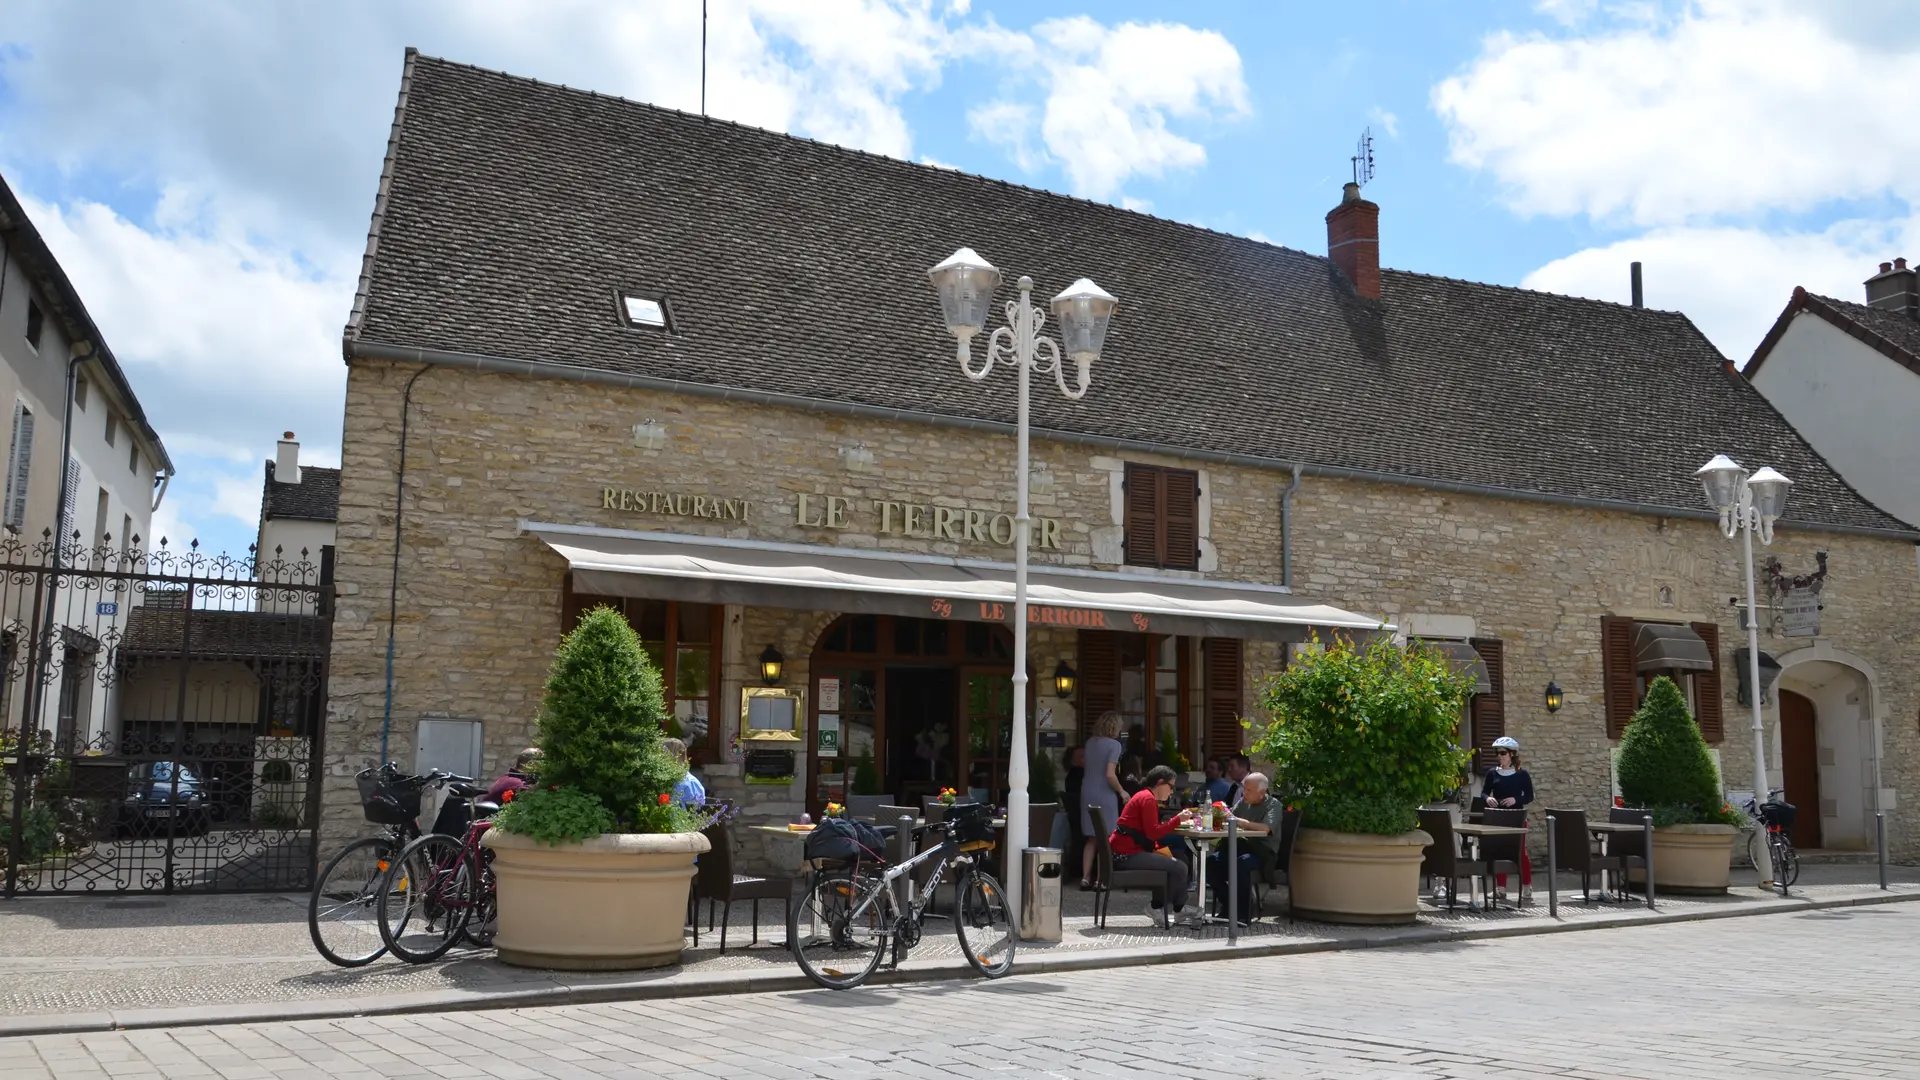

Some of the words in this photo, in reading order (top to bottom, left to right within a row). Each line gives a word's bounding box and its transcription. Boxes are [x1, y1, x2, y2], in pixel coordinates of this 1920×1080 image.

[602, 487, 752, 521] RESTAURANT
[796, 493, 851, 529] LE
[101, 604, 114, 614] 18
[979, 602, 1005, 620] LE
[1013, 603, 1106, 628] ERROIR
[924, 857, 948, 901] SCOTT
